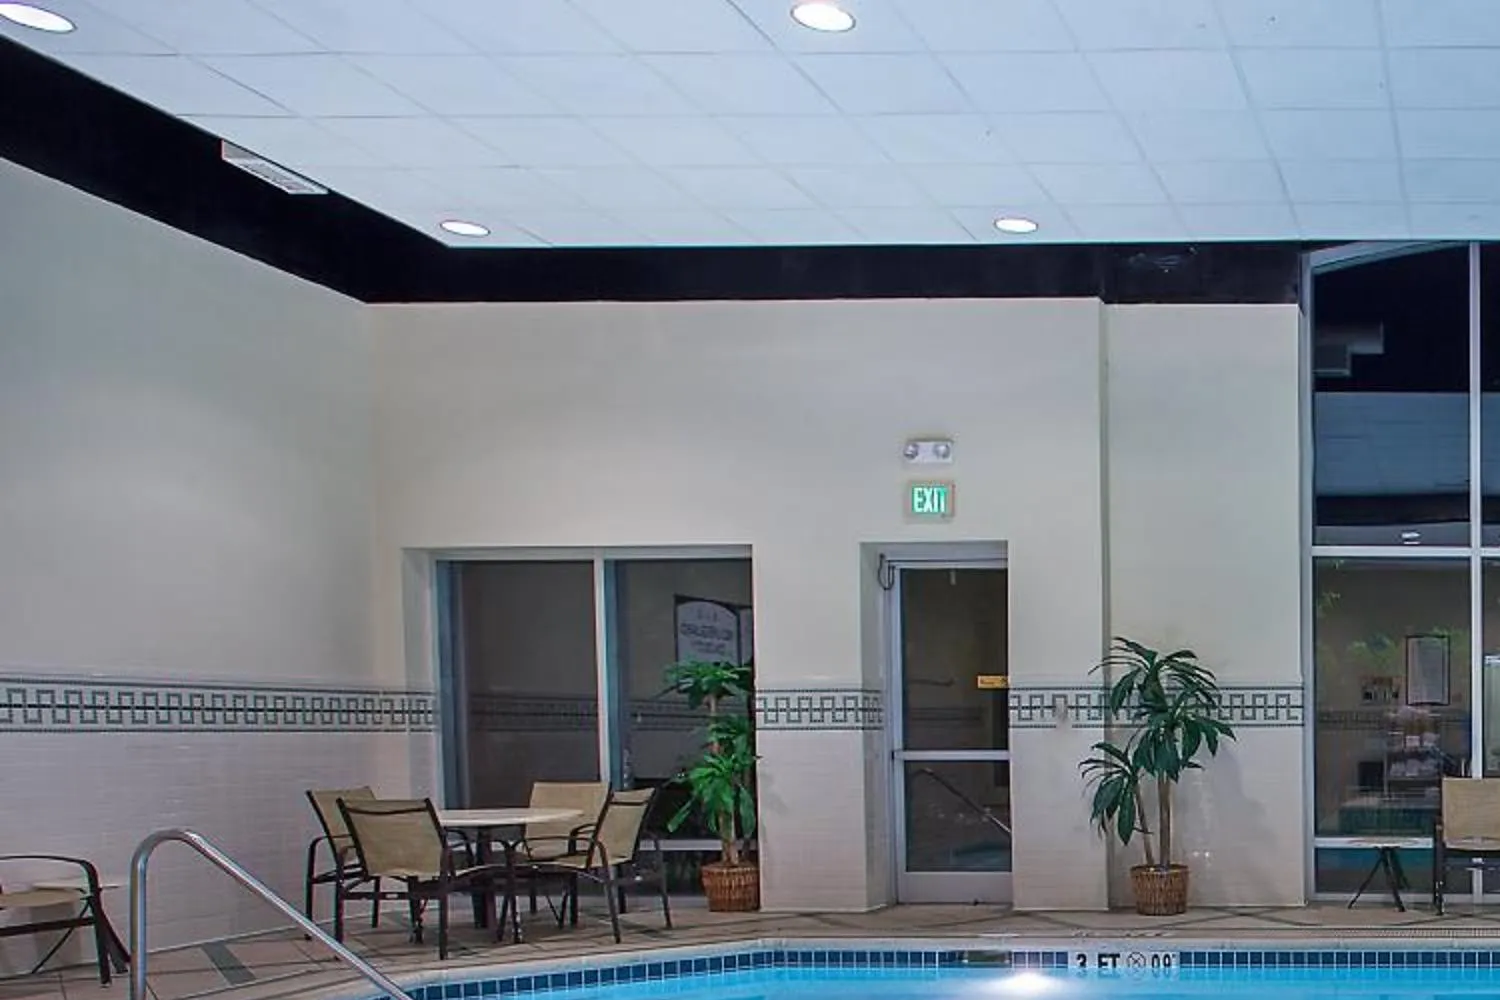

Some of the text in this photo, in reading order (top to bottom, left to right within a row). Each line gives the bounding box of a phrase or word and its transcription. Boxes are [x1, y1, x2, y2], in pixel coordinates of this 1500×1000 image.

[913, 487, 947, 513] EXIT
[1076, 952, 1087, 969] 3
[1097, 953, 1120, 969] FT
